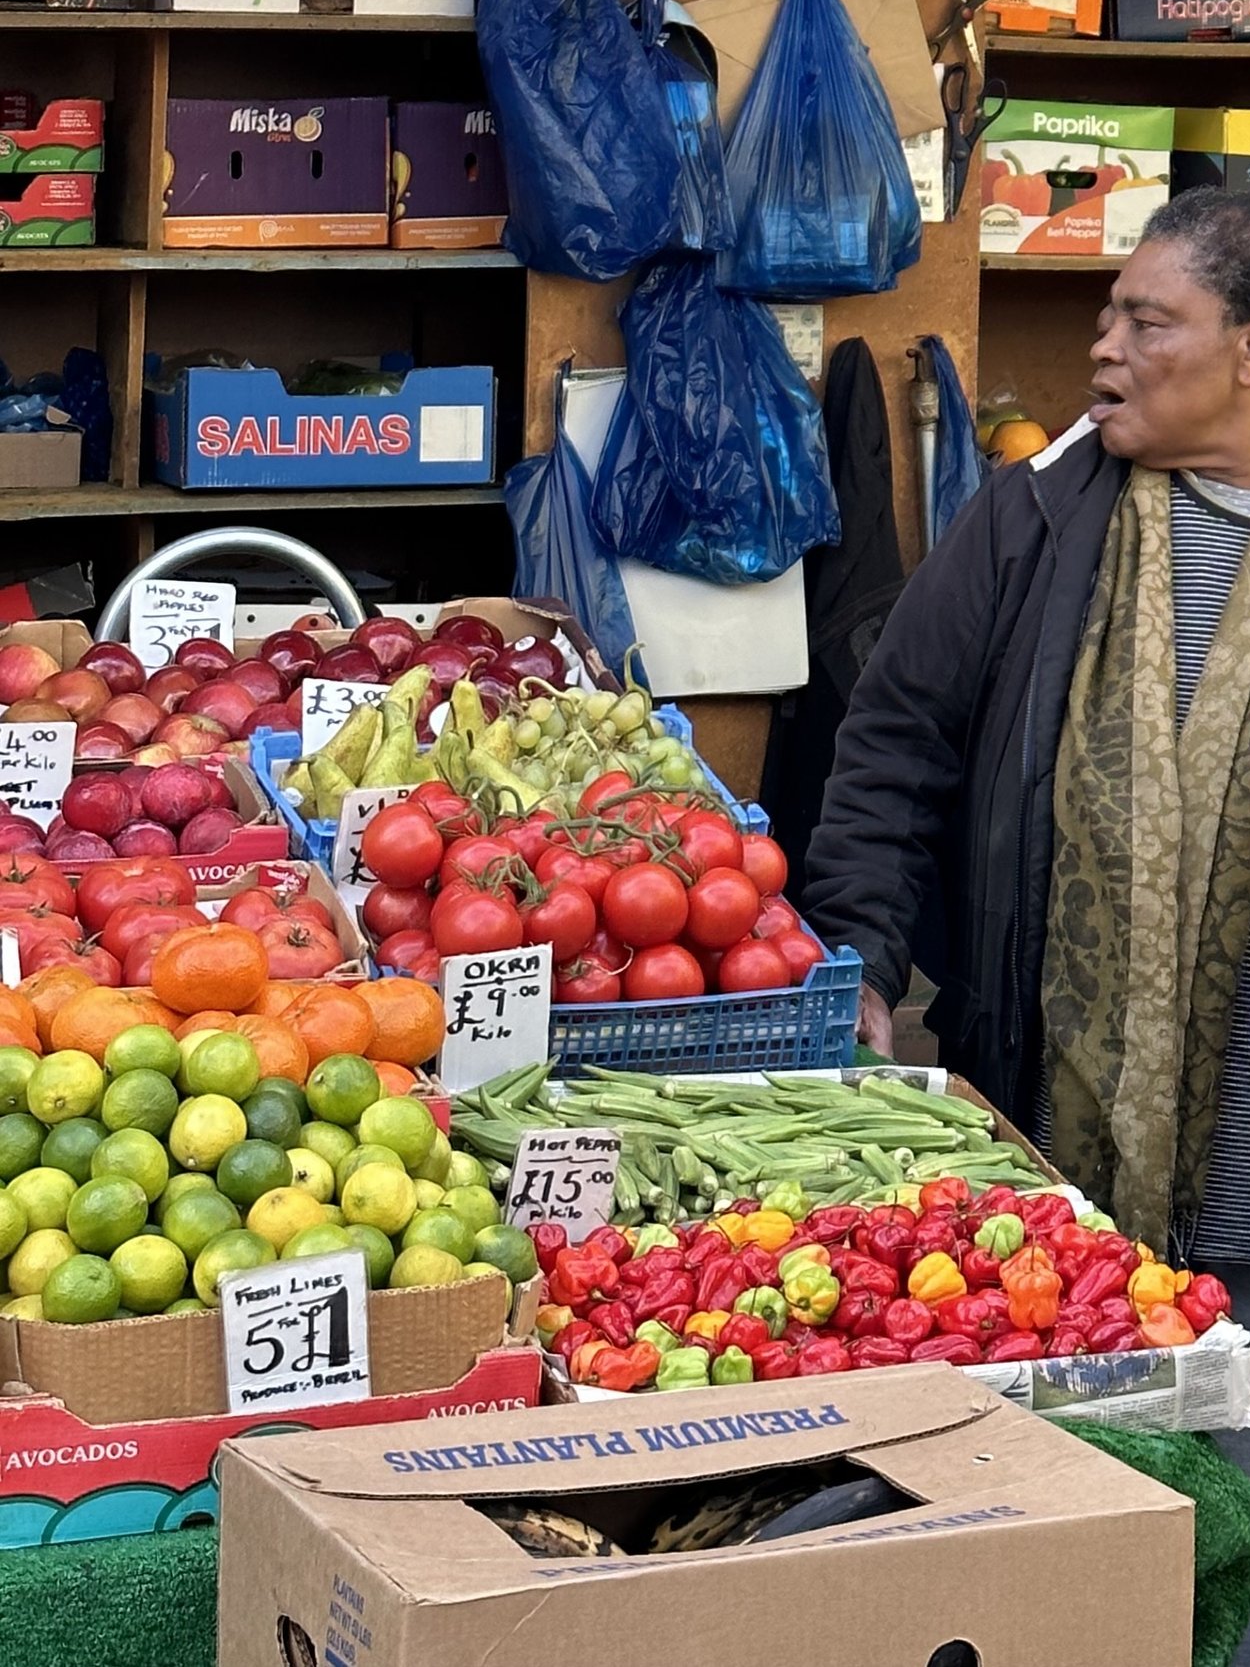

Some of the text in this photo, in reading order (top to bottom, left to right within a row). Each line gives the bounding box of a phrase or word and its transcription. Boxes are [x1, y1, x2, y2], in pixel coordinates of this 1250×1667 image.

[229, 107, 292, 134] Miska
[1032, 111, 1121, 138] Paprika
[196, 413, 412, 457] SALINAS
[463, 954, 541, 981] OKRA
[528, 1138, 569, 1152] HOT
[290, 1273, 344, 1295] LIMES
[243, 1318, 285, 1375] 5
[383, 1404, 851, 1474] PREMIUM PLANTAINS
[5, 1440, 139, 1472] AVOCADOS
